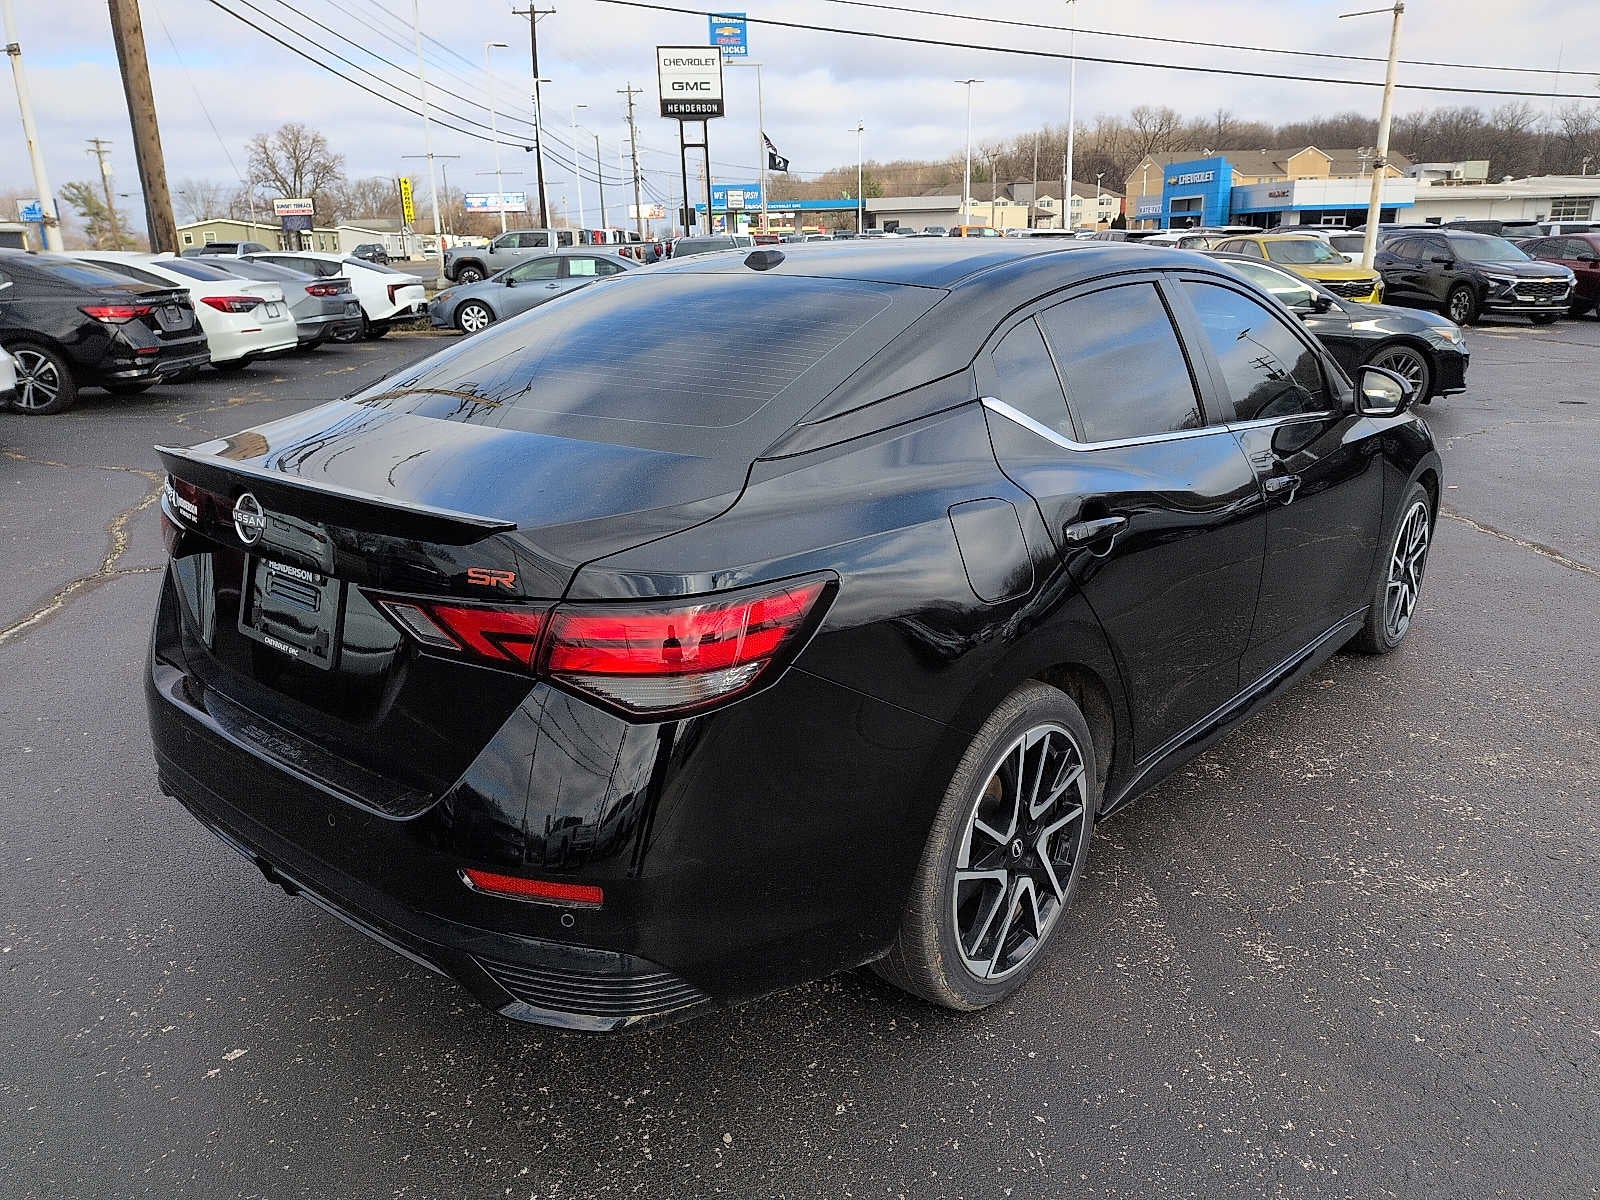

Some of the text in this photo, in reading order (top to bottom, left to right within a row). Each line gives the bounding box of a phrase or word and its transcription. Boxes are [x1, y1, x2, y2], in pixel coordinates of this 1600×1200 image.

[722, 46, 746, 54] UCKS
[663, 58, 716, 67] CHEVROLET
[671, 81, 711, 91] GMC
[667, 103, 718, 113] HENDERSON
[1178, 170, 1215, 185] CHEVROLET
[233, 511, 265, 528] ISSAN
[268, 560, 313, 582] HENDERSON
[467, 567, 517, 589] SR
